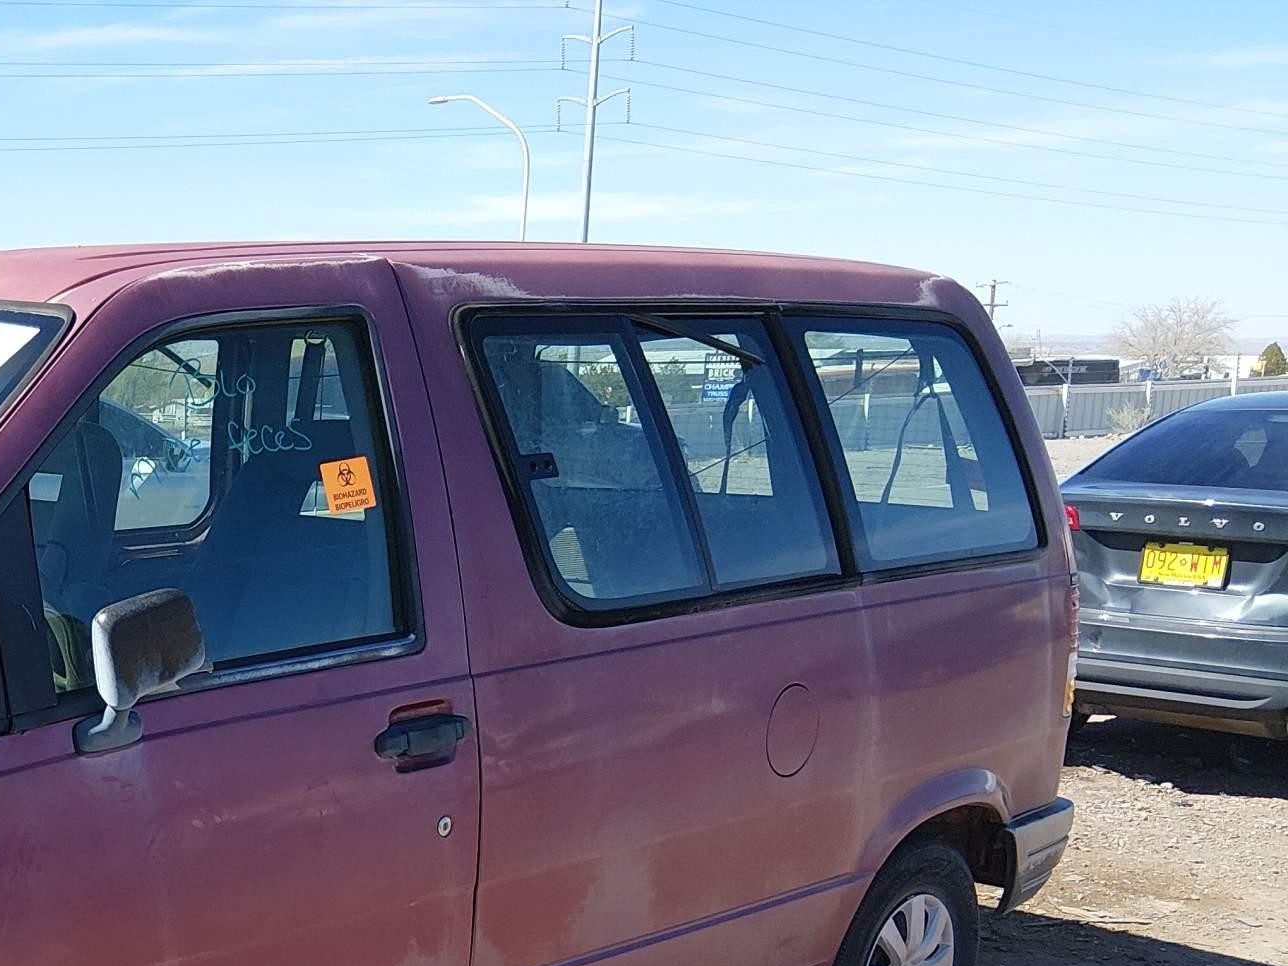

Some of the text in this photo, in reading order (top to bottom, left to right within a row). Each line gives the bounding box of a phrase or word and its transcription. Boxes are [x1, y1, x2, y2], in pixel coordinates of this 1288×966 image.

[709, 368, 736, 377] BRICK
[332, 488, 367, 501] BIOHAZARD
[334, 498, 370, 511] BIOPELIGRO
[1109, 511, 1265, 532] VOLVO
